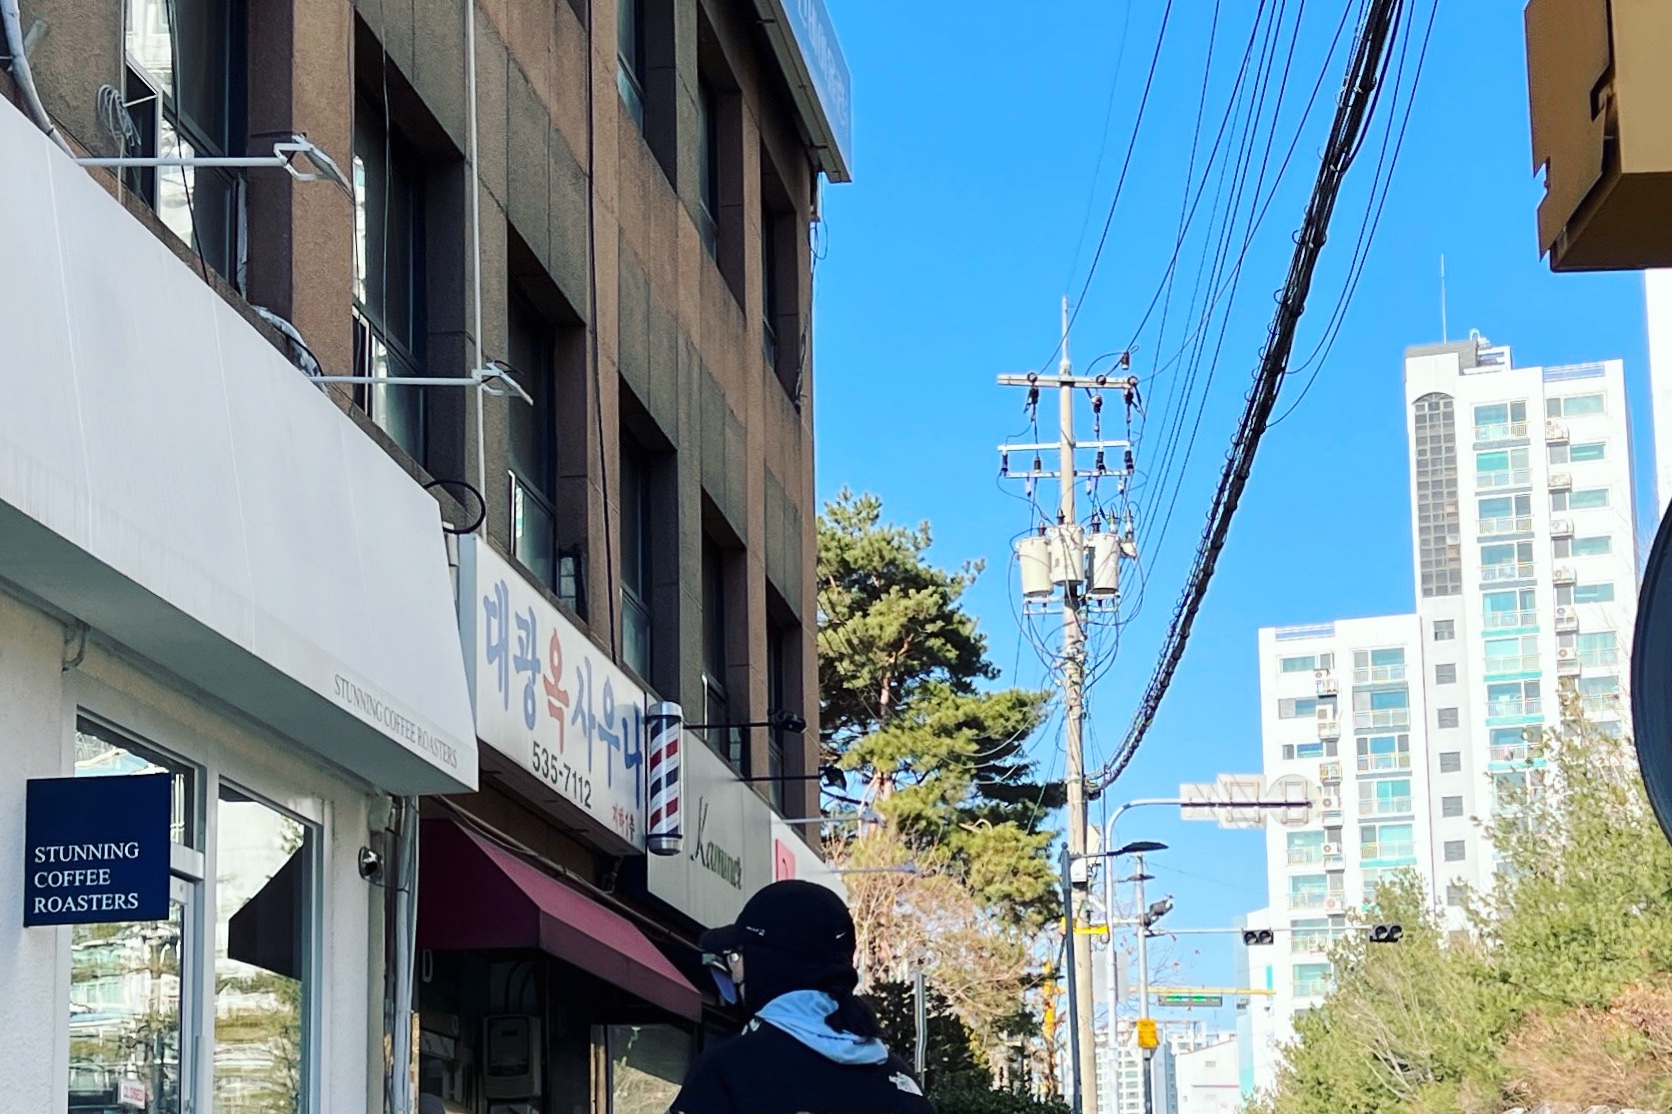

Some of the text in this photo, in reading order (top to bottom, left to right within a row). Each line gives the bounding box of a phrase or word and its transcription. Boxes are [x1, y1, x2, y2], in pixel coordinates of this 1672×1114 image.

[334, 673, 457, 769] STUNNING COFFEE ROASTERS
[532, 741, 592, 810] 535-7112
[34, 842, 139, 863] STUNNING
[34, 869, 111, 888] COFFEE
[33, 893, 139, 914] ROASTERS
